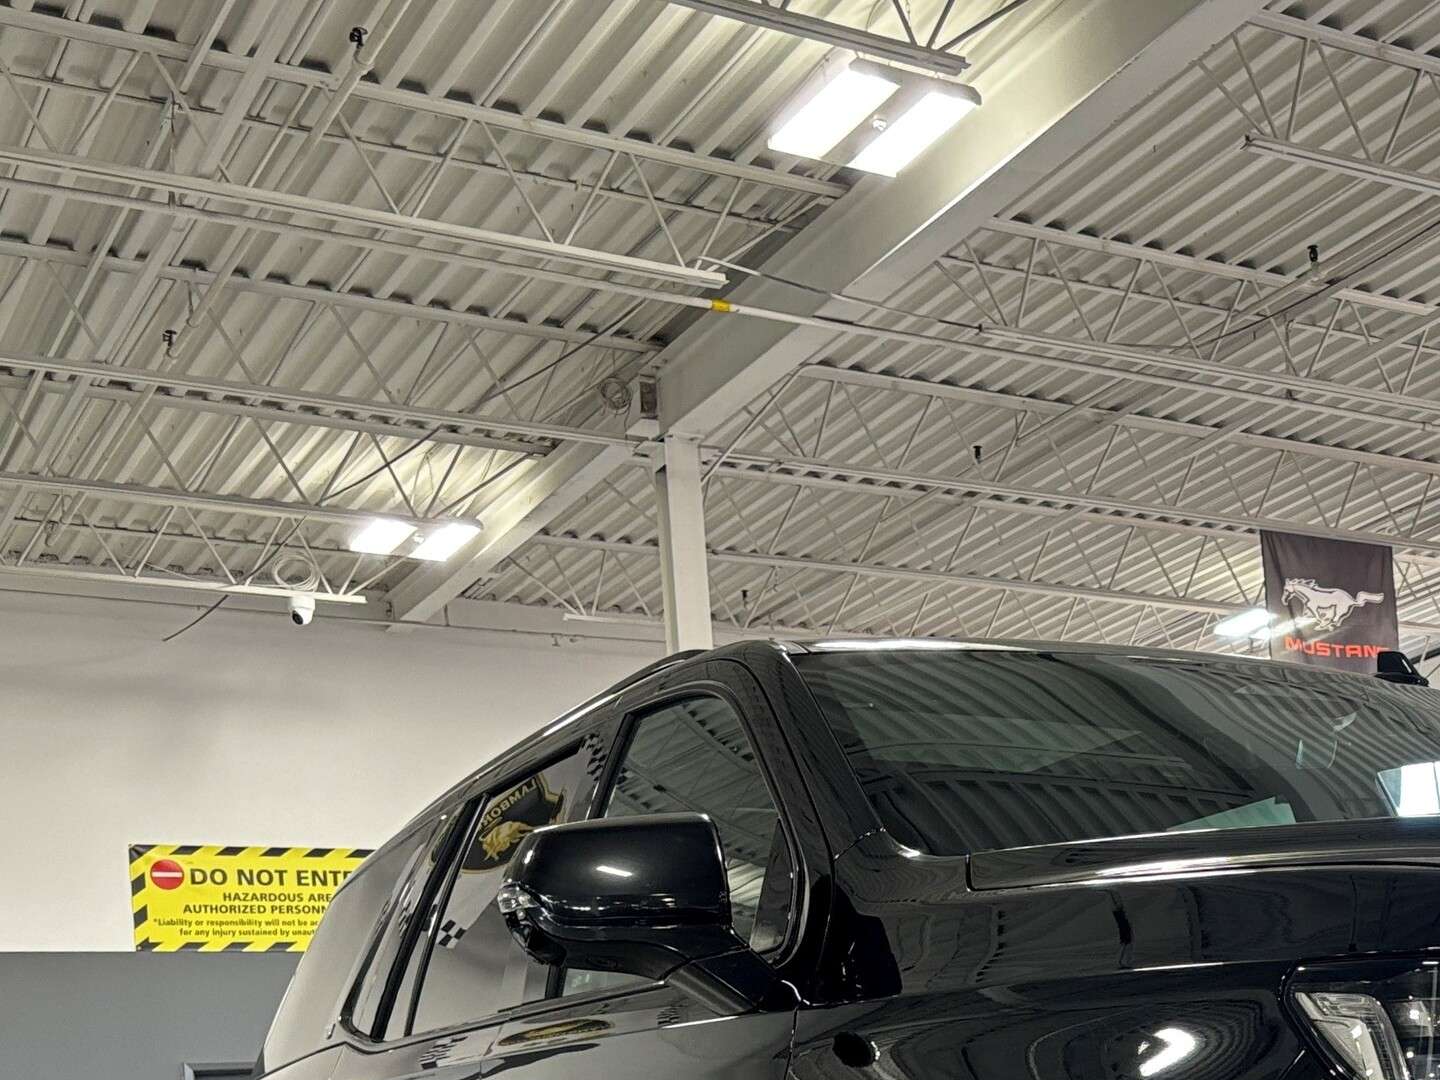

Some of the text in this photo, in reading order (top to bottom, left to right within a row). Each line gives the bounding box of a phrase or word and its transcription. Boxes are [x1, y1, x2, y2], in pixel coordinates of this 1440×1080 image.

[190, 868, 228, 886] DO
[237, 869, 288, 887] NOT
[223, 892, 304, 902] HAZARDOUS
[183, 904, 266, 915] AUTHORIZED
[207, 918, 263, 928] responsibility
[265, 918, 280, 926] will
[180, 928, 192, 936] for
[238, 928, 278, 936] sustained
[280, 928, 290, 937] by
